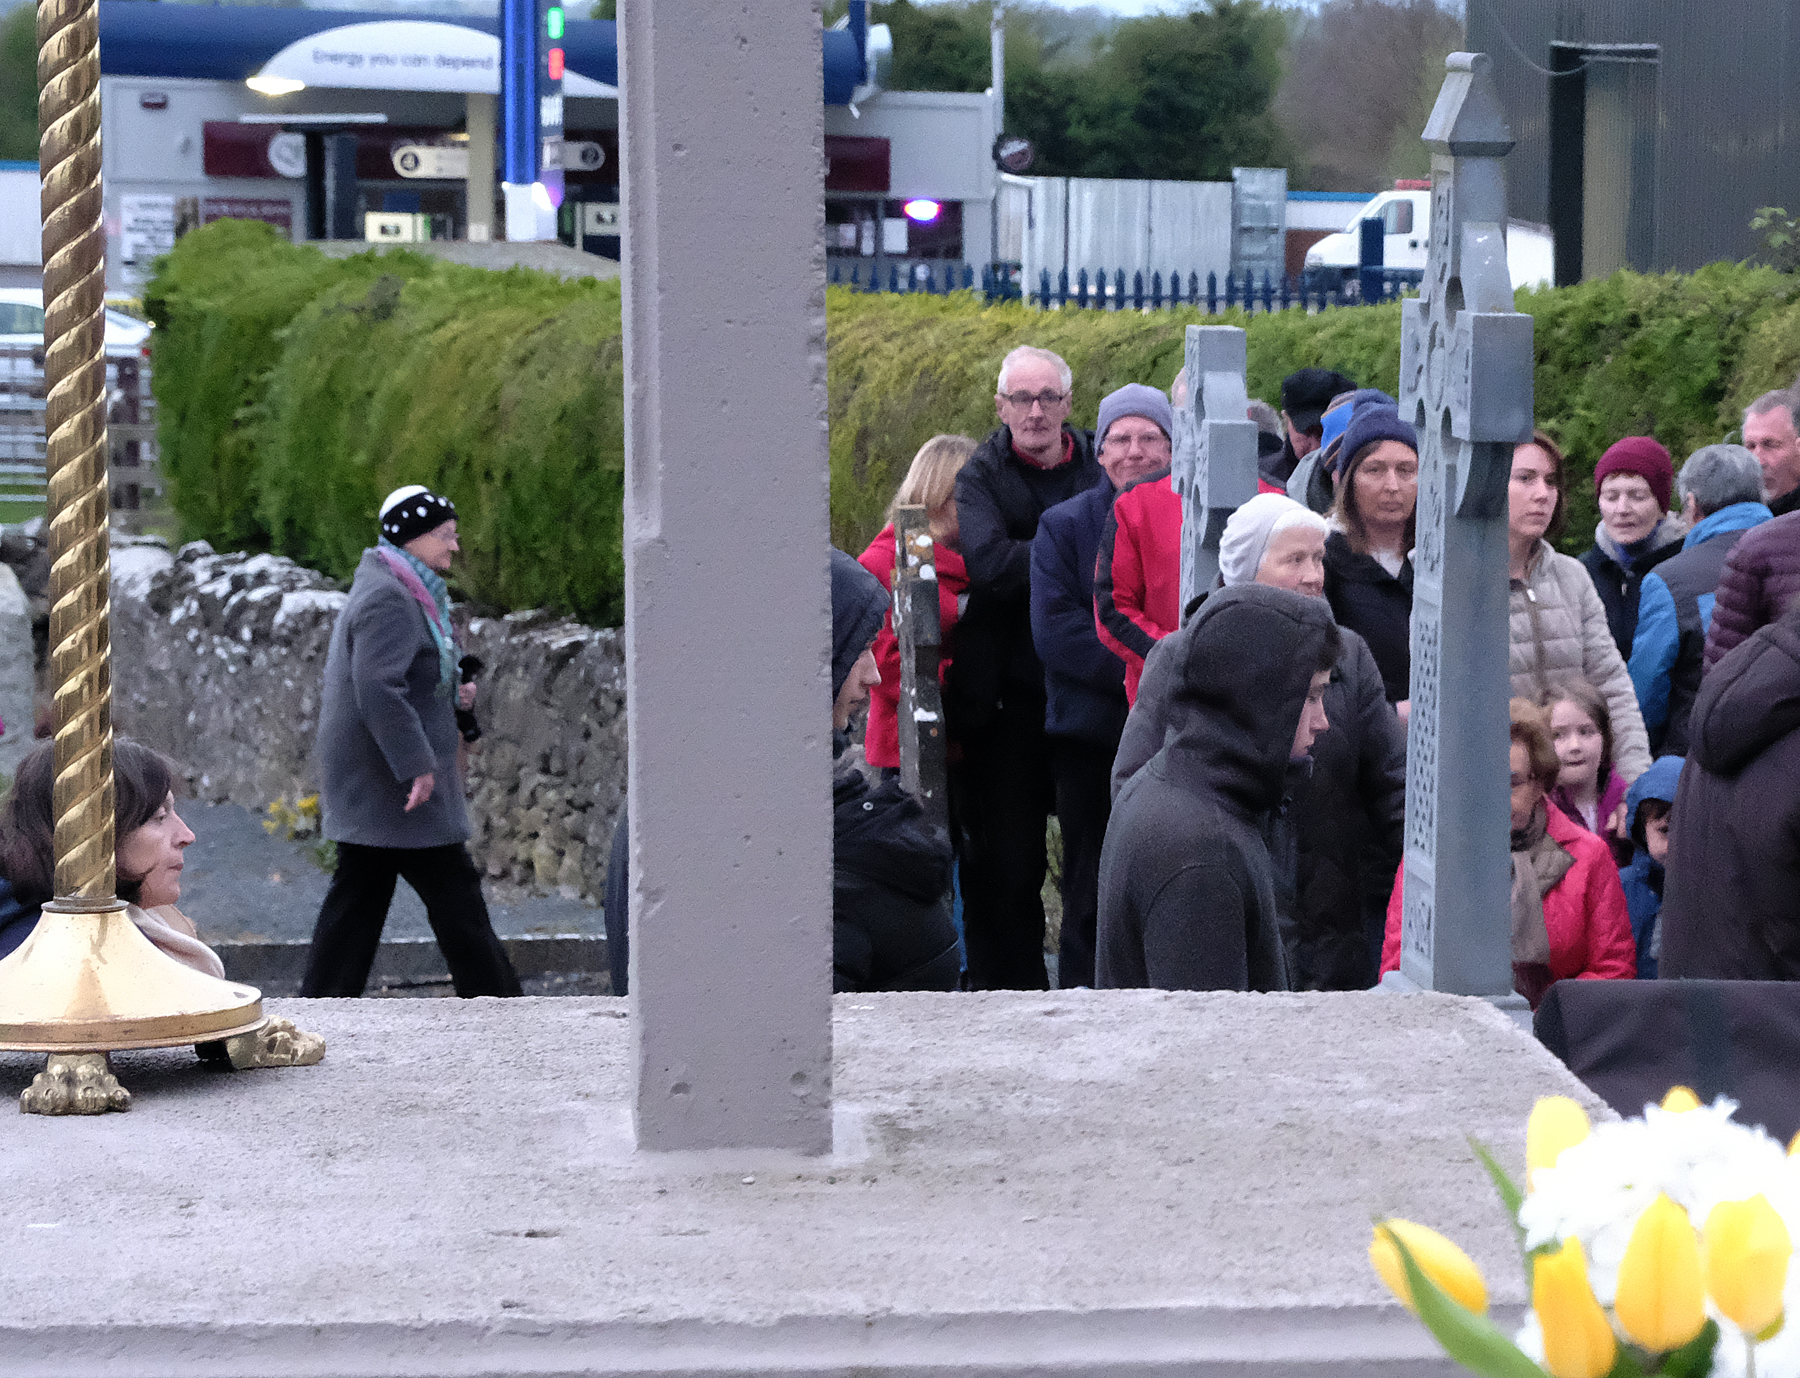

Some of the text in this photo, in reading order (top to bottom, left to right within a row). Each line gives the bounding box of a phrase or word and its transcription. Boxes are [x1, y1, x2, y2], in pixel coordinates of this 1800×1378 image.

[313, 47, 495, 71] Energy you can depend
